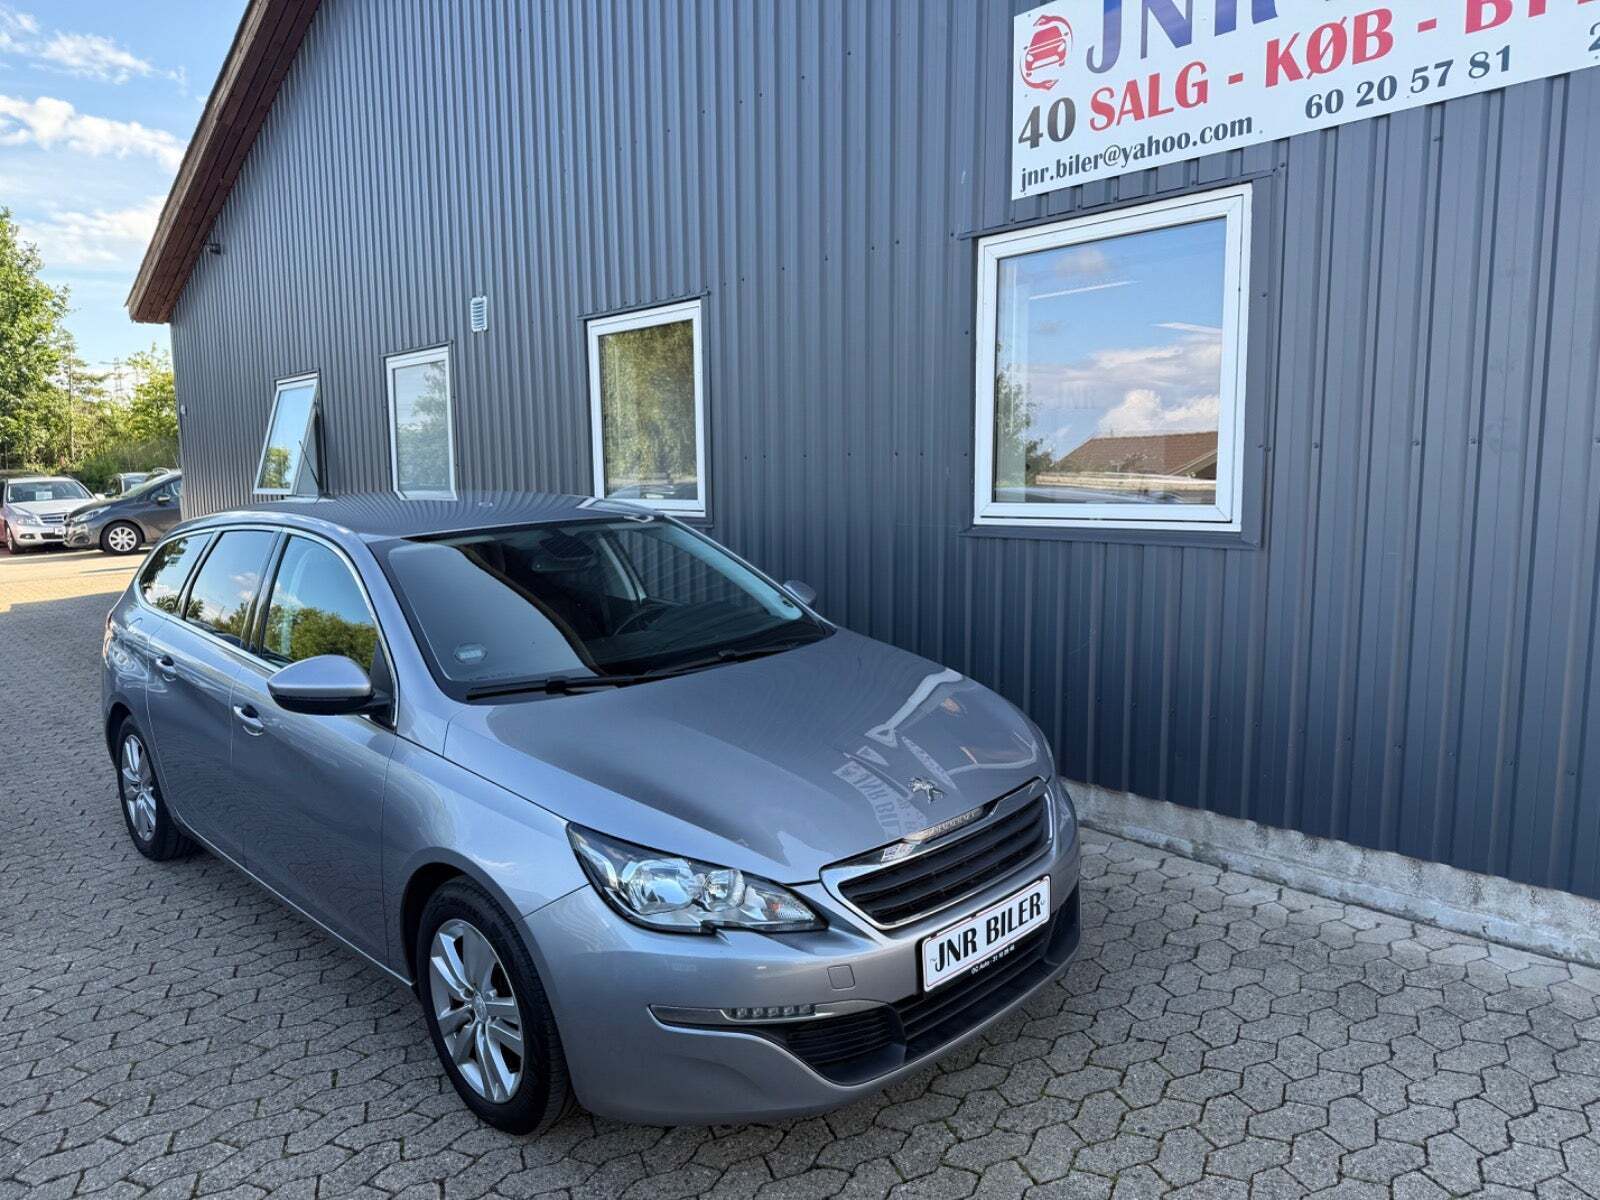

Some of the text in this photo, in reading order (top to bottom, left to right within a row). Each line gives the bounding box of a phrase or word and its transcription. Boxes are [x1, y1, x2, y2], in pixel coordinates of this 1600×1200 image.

[1018, 97, 1076, 149] 40
[1089, 61, 1209, 132] SALG
[1265, 8, 1394, 88] KØB
[1305, 89, 1344, 120] 60
[1356, 74, 1398, 107] 20
[1410, 59, 1454, 94] 57
[1468, 45, 1511, 79] 81
[1020, 116, 1252, 192] jnr.biler@yahoo.com
[935, 892, 1042, 972] JNR BILER
